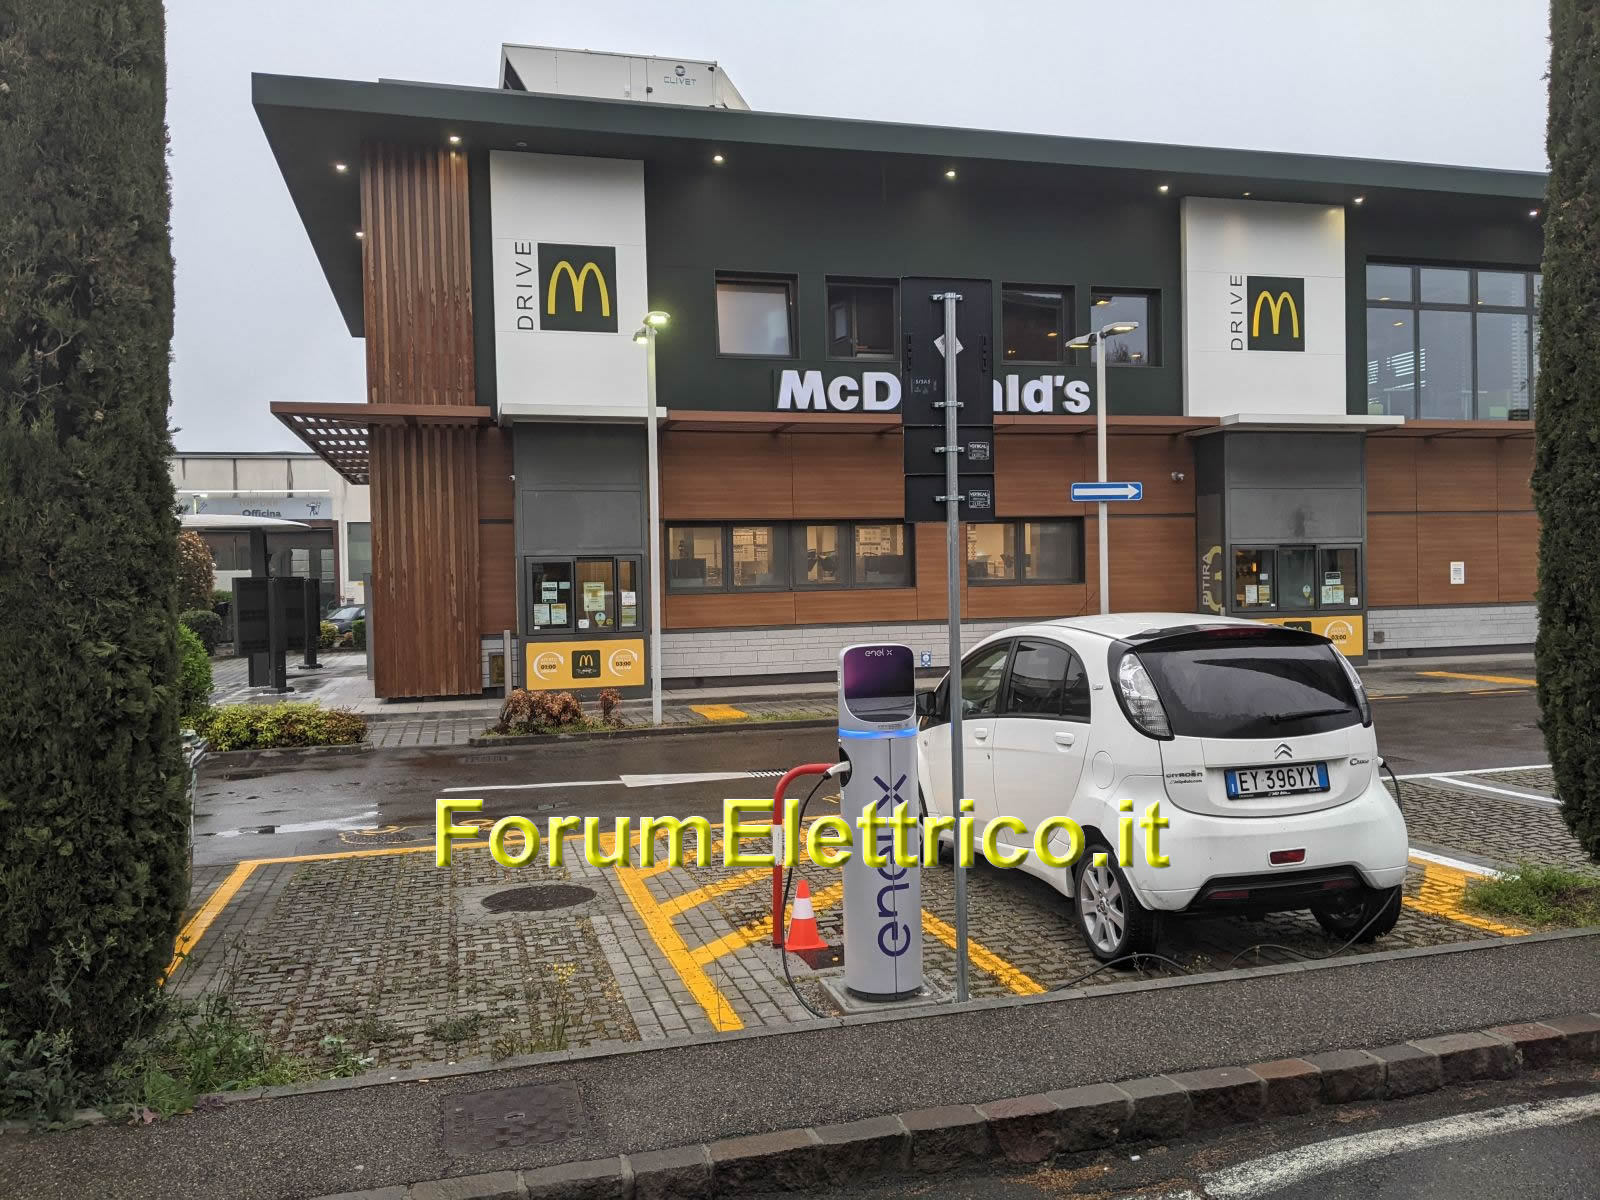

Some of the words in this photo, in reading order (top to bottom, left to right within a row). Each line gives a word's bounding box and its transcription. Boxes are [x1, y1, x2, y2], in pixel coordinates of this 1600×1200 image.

[664, 76, 697, 86] CLIVET
[515, 241, 534, 330] DRIVE
[1230, 274, 1243, 351] DRIVE
[777, 369, 1091, 413] McDld's
[864, 648, 884, 657] enel
[1238, 771, 1259, 792] EY
[1264, 766, 1318, 790] 396YX
